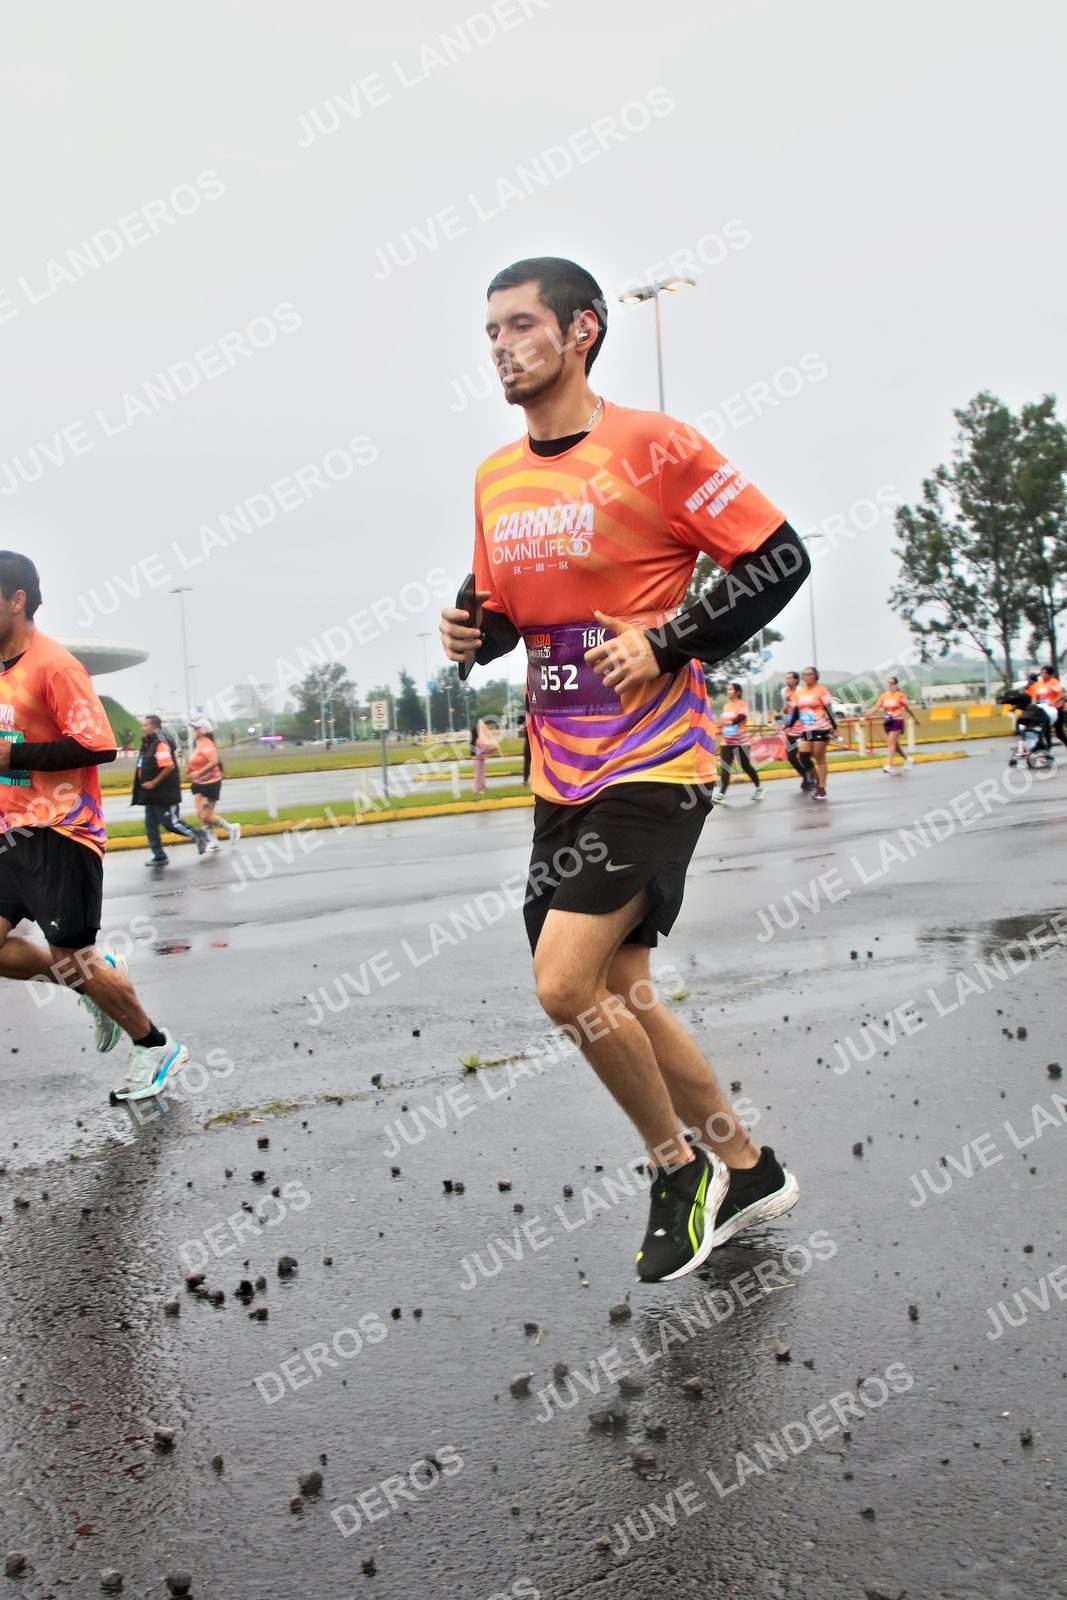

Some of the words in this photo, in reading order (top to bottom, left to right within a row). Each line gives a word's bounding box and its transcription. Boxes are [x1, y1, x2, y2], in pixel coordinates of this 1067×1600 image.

[493, 502, 594, 543] CARRERA
[492, 538, 566, 565] OMNILIFE
[535, 563, 545, 572] 10K
[582, 628, 606, 648] 15K
[540, 664, 579, 691] 552
